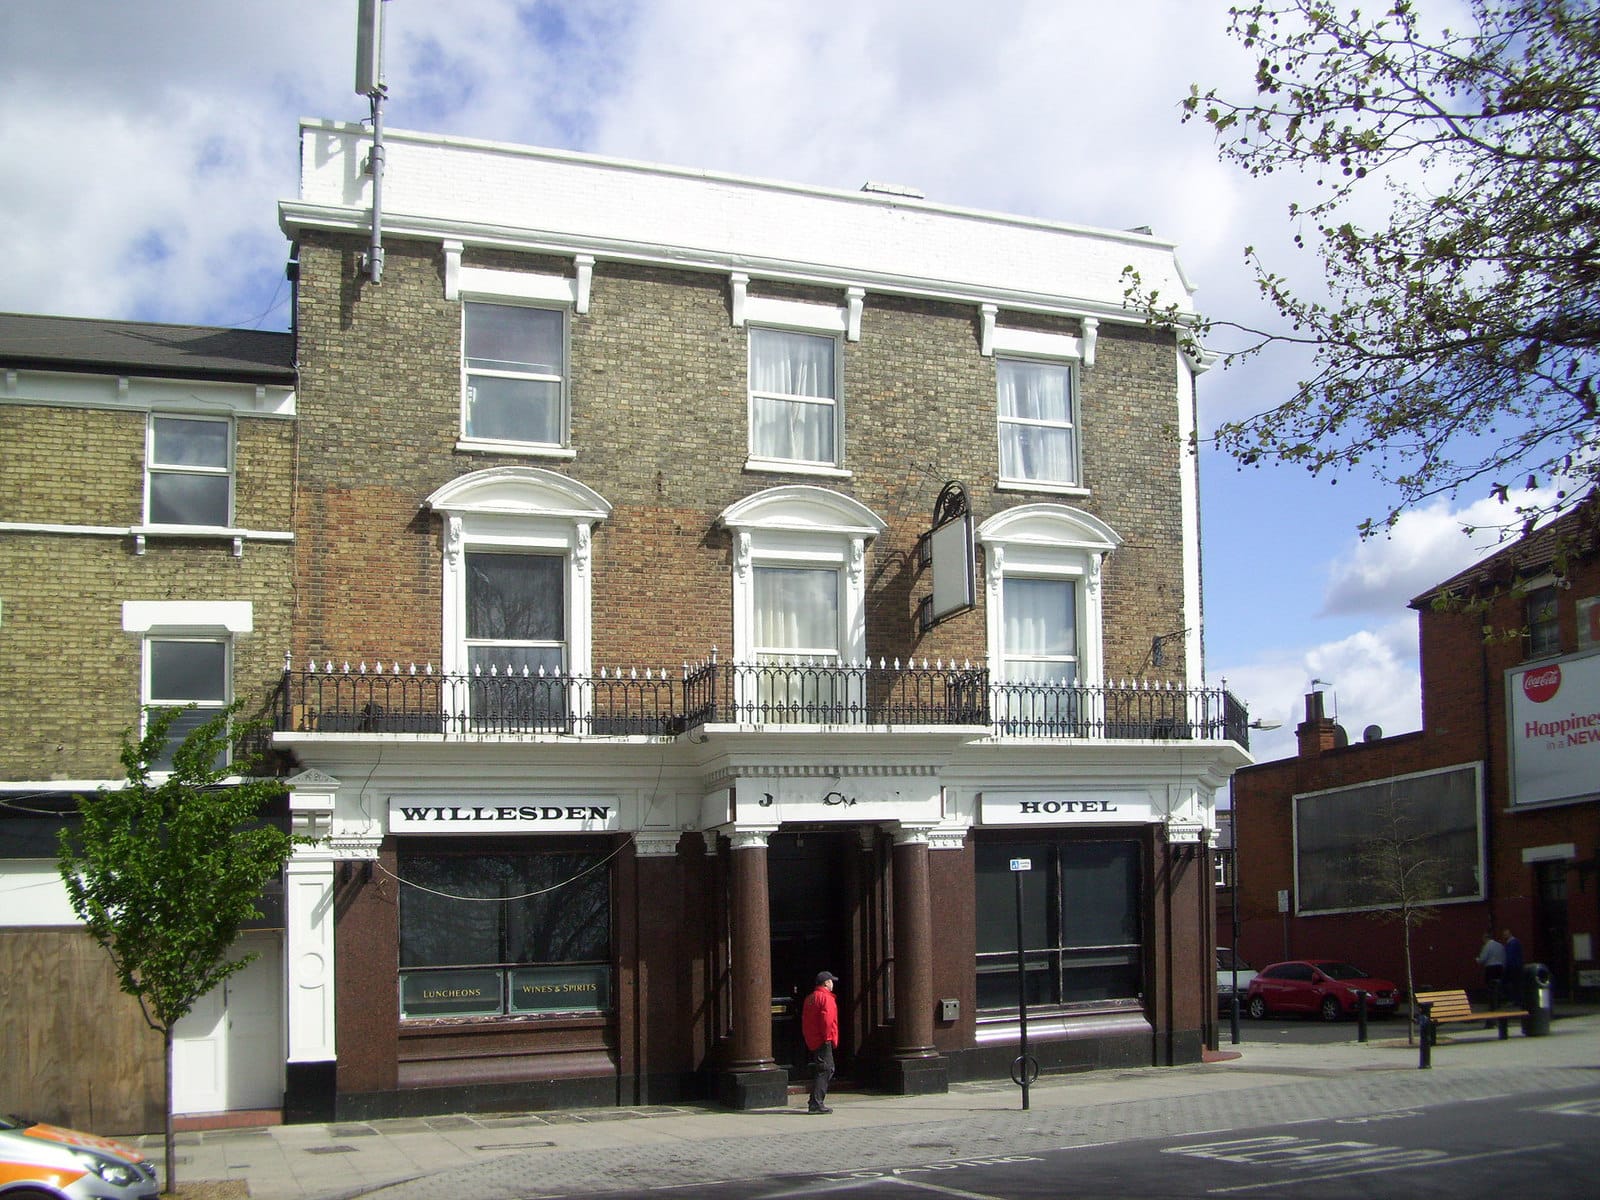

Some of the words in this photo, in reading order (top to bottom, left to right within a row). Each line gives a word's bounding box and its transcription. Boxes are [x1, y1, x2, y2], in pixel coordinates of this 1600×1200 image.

[400, 806, 611, 821] WILLESDEN
[1019, 801, 1117, 814] HOTEL
[423, 988, 481, 999] LUNCHEONS
[522, 984, 553, 993] WINES
[554, 985, 561, 993] &
[563, 983, 597, 993] SPIRITS
[819, 1155, 1047, 1181] LOADING
